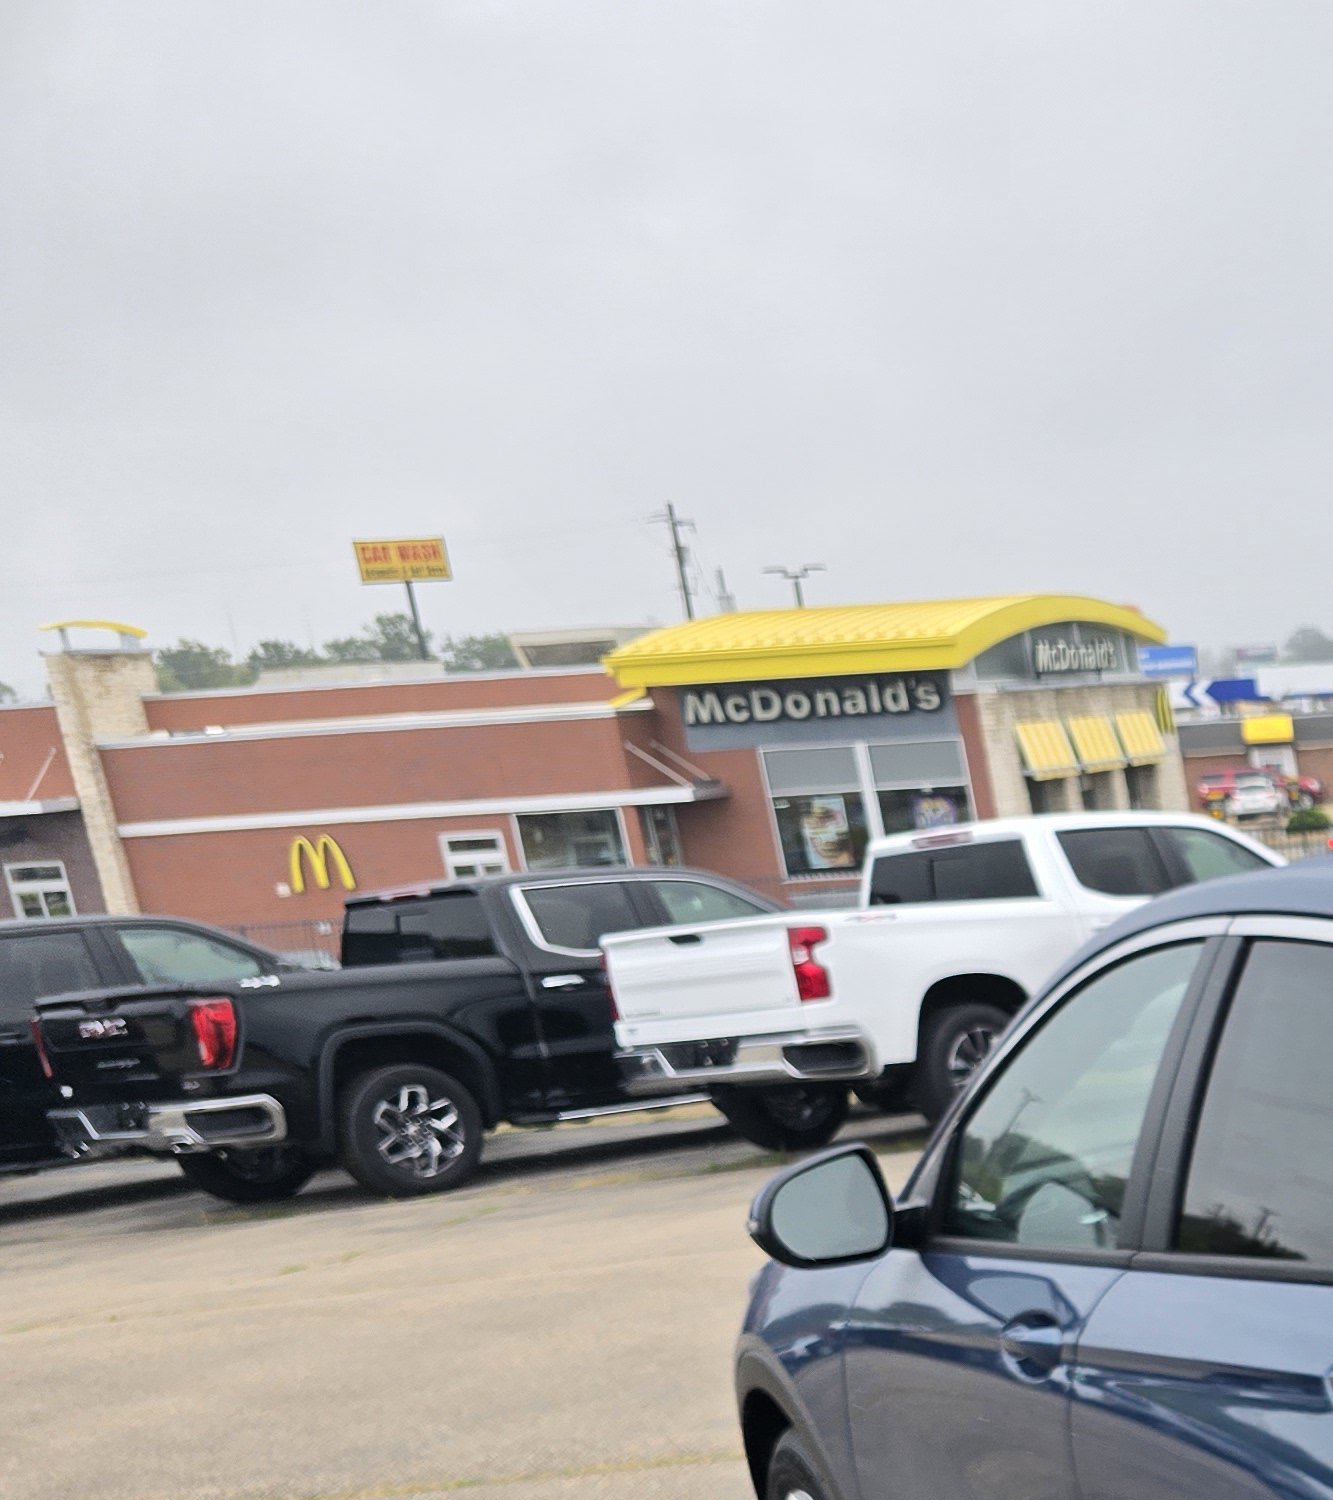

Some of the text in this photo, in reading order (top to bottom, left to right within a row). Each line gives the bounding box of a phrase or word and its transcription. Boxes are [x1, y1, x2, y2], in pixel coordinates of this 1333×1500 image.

[360, 542, 442, 565] CAR WASH
[1035, 637, 1119, 673] McDonald's
[684, 677, 941, 726] McDonald's
